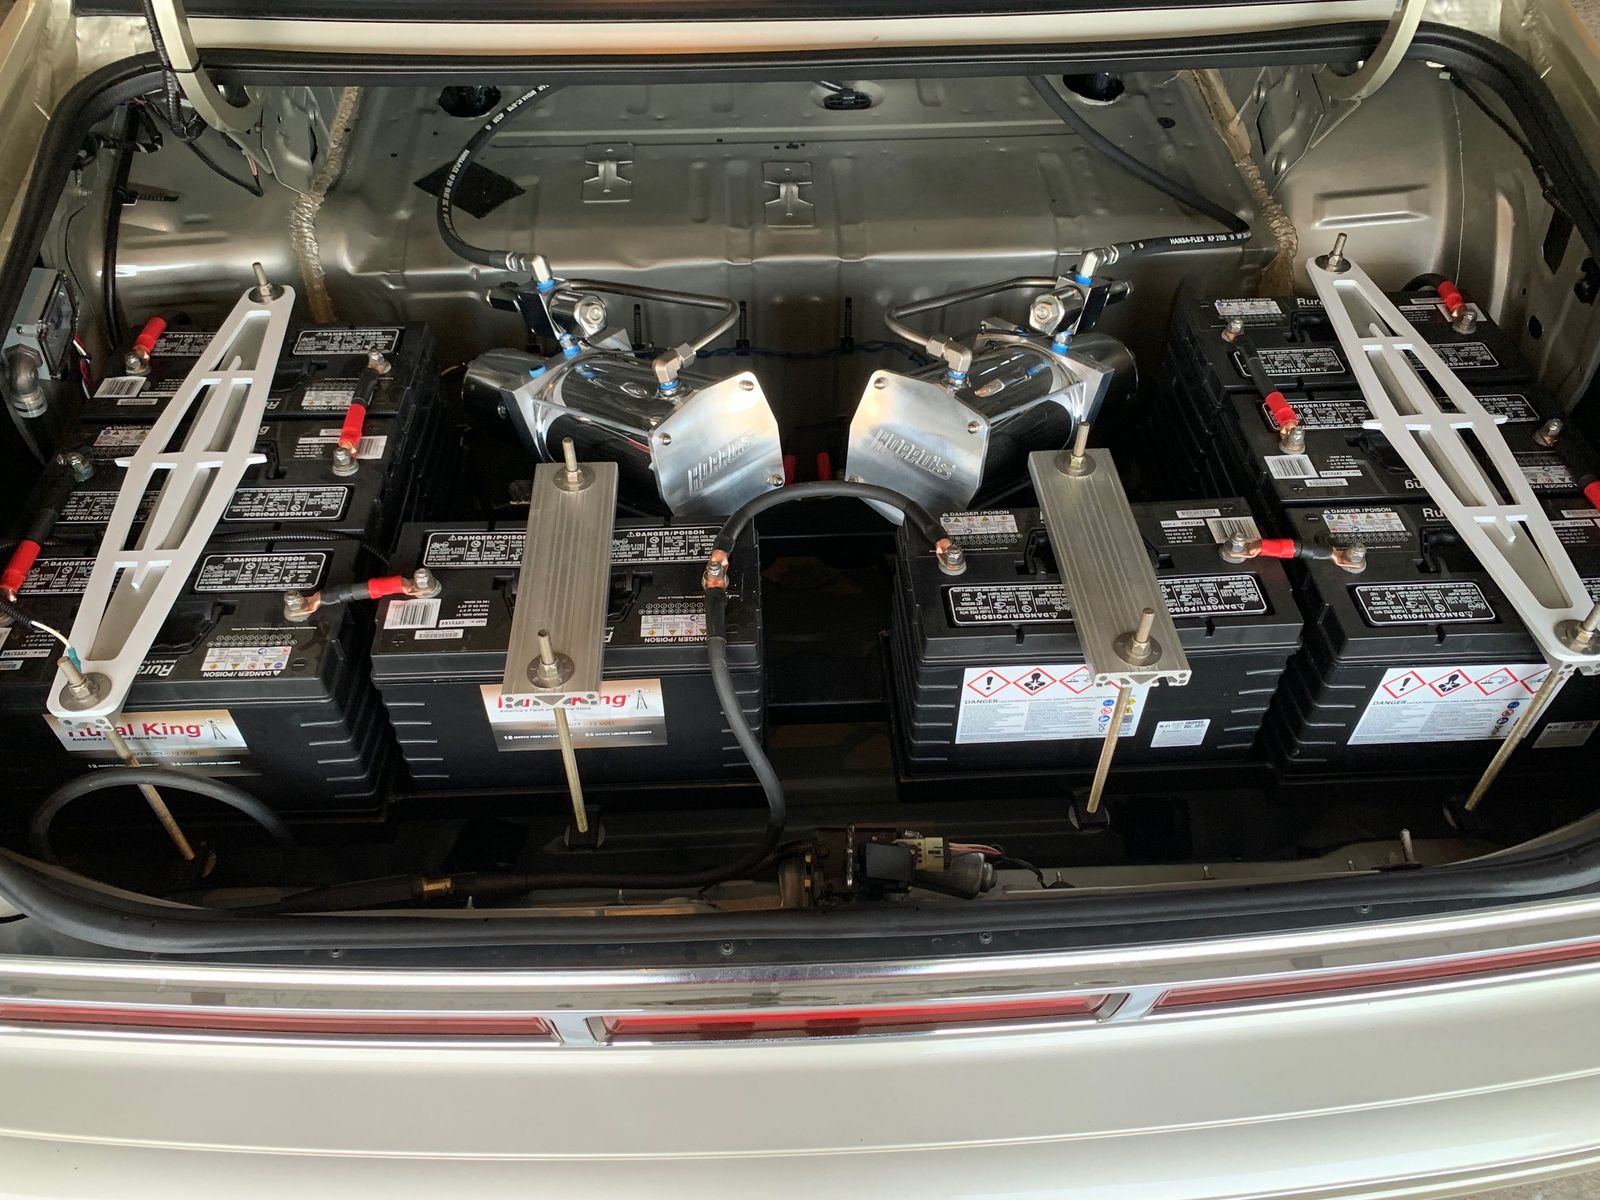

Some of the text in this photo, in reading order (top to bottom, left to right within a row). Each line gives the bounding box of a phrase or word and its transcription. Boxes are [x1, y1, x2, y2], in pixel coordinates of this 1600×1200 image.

[1296, 297, 1323, 305] Rur
[635, 529, 705, 537] DANGER/POISON
[1168, 603, 1237, 613] DANGER/POISO
[975, 612, 1050, 620] DANGER/POISON
[1390, 611, 1465, 620] DANGER/POISON
[136, 664, 175, 677] Rura
[142, 723, 202, 738] King
